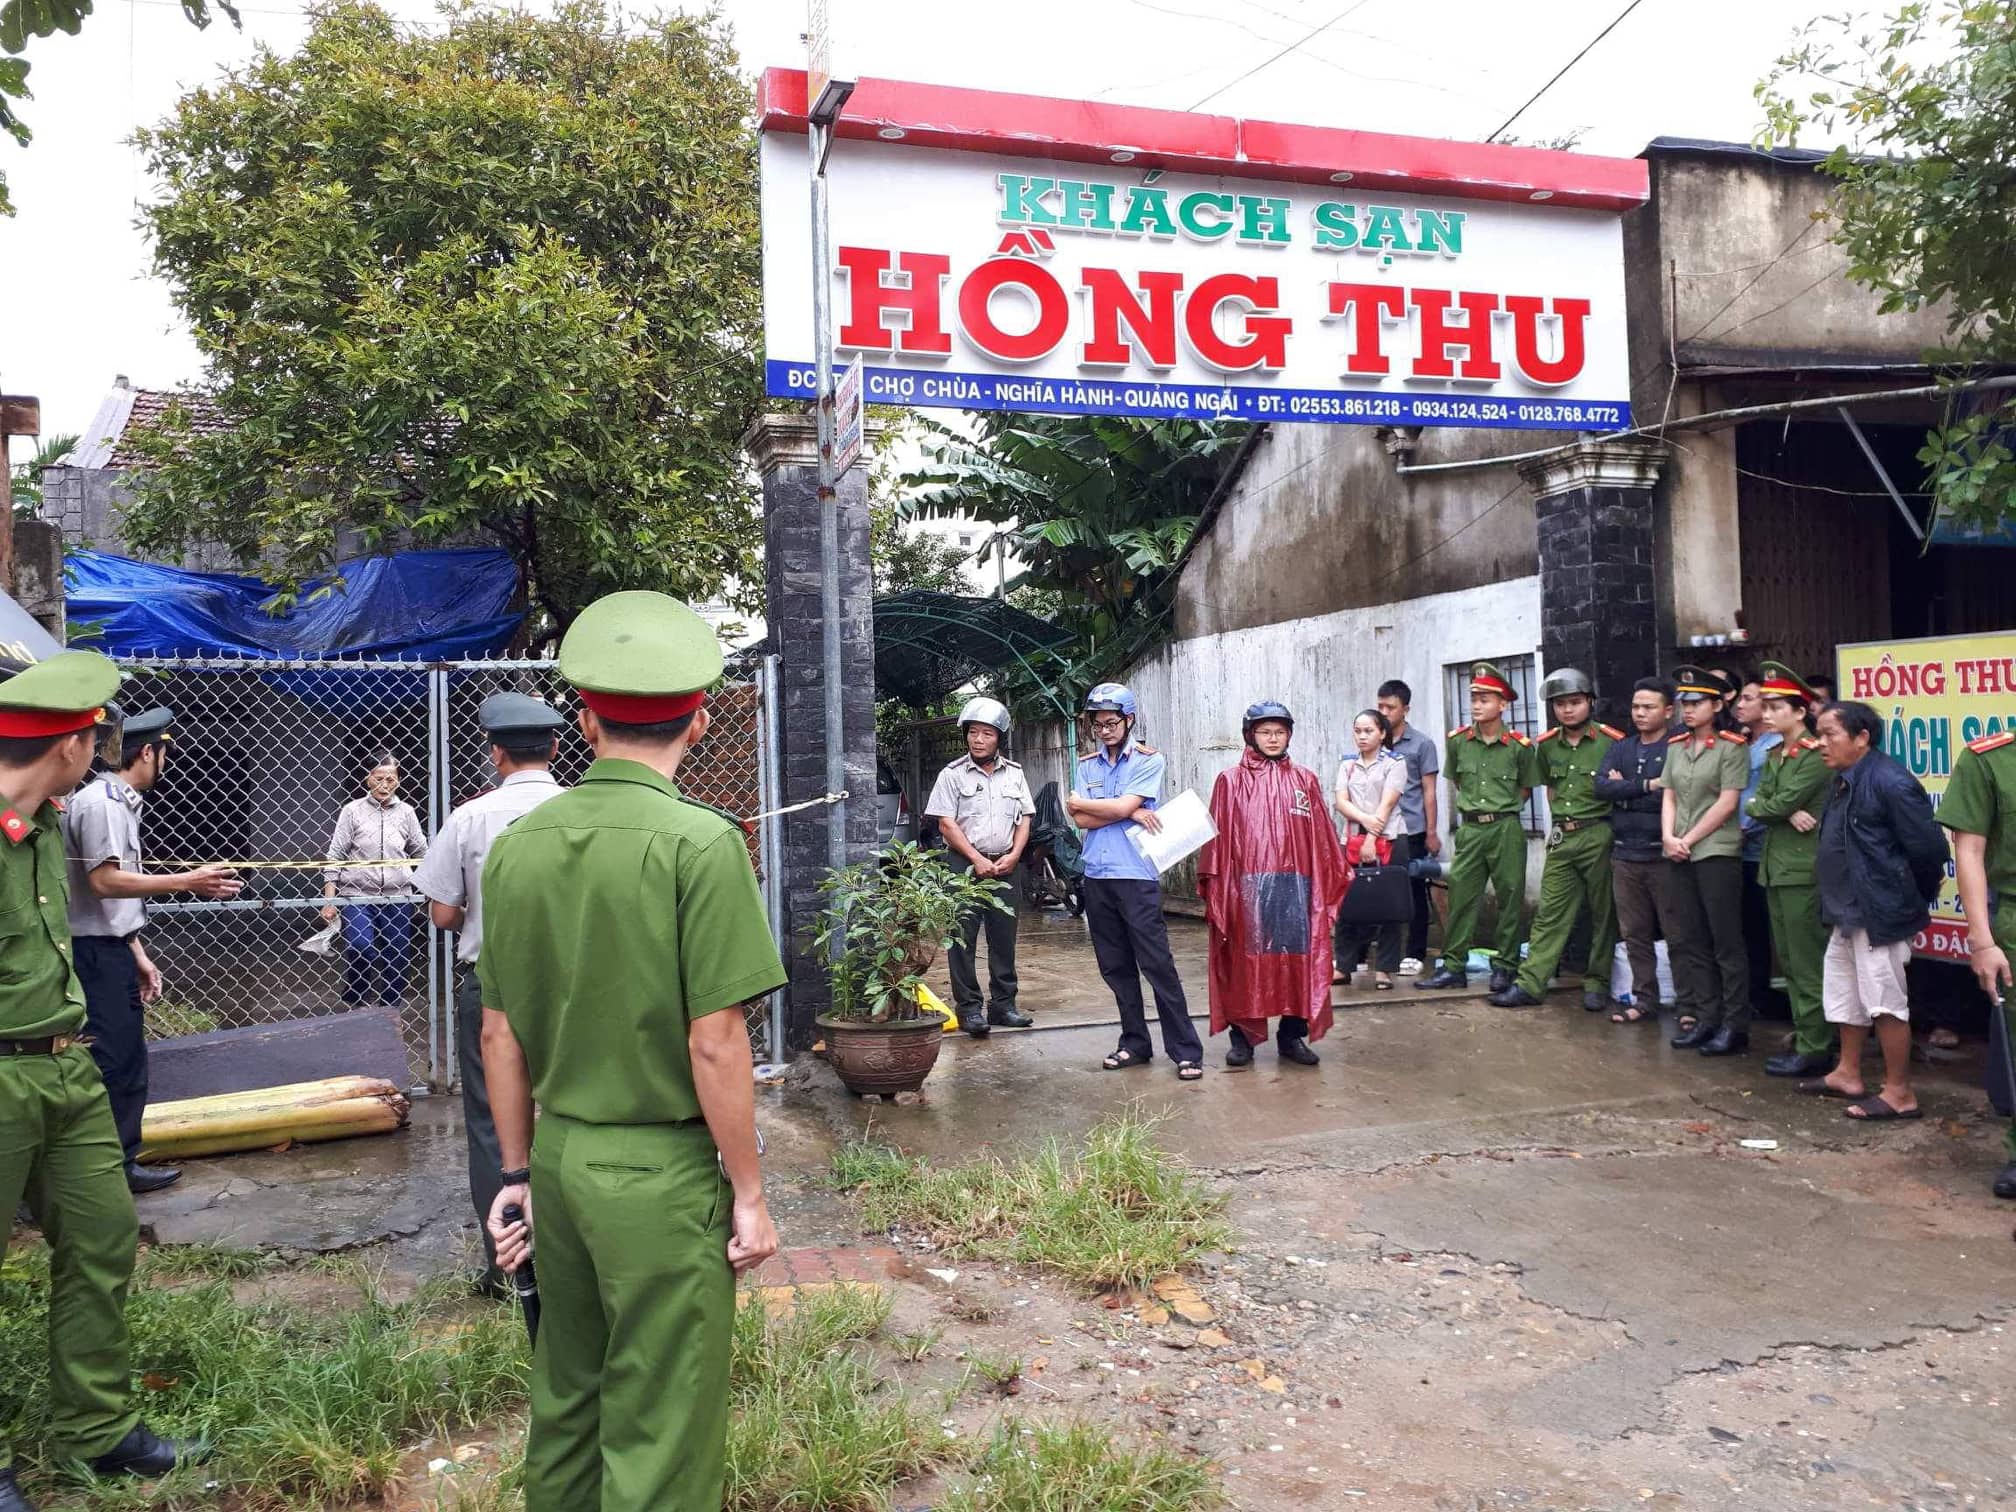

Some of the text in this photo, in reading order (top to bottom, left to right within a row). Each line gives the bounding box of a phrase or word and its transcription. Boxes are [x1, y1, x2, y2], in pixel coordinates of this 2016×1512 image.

[998, 170, 1467, 265] KHÁCH SẠN
[838, 229, 1592, 384] HỒNG THU
[870, 375, 915, 403] CHỢ
[923, 376, 981, 400] CHÙA
[995, 382, 1057, 404] NGHĨA
[1258, 395, 1286, 413] ĐT:
[1290, 397, 1400, 416] 02553.861.218
[1519, 405, 1620, 423] 0128.768.4772
[1852, 653, 1946, 698] HỒNG
